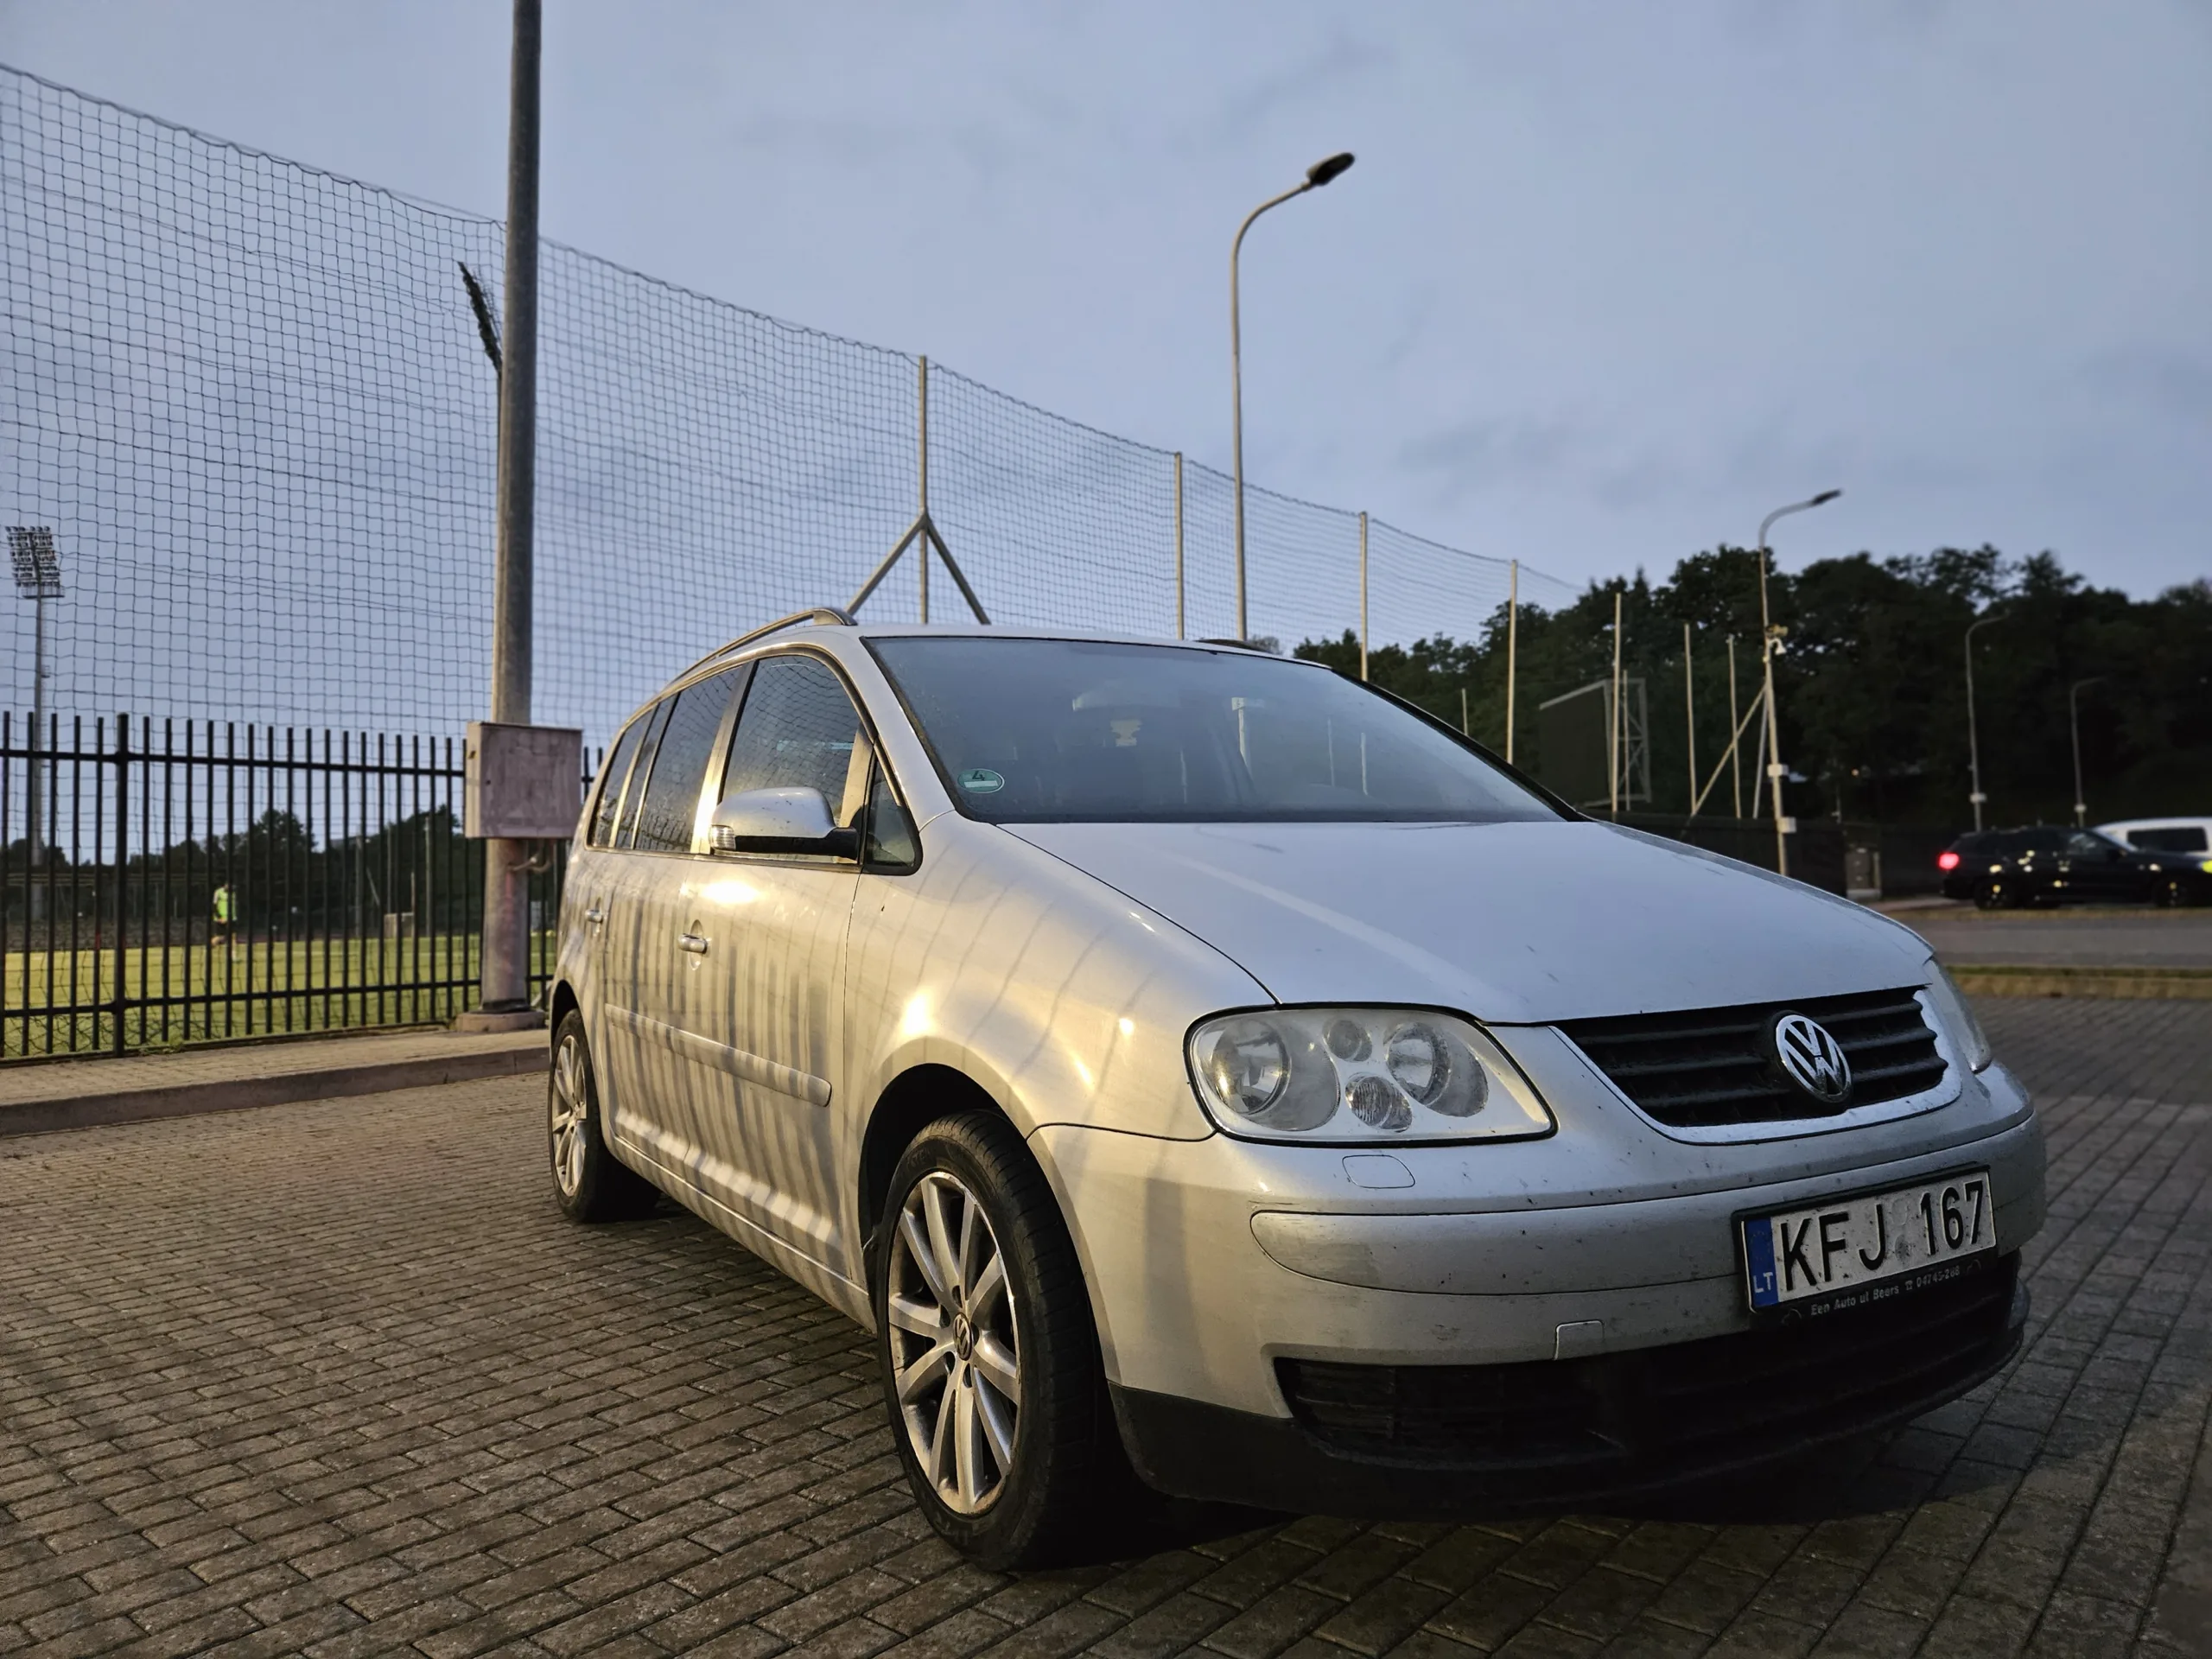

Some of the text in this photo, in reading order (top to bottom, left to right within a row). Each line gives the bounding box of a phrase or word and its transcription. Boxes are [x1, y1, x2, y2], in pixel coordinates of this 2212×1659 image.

[971, 770, 985, 781] 4
[1780, 1180, 1983, 1291] KFJ 167
[1753, 1271, 1774, 1294] LT
[1811, 1303, 1830, 1316] Een
[1834, 1295, 1856, 1310] Auto
[1872, 1285, 1900, 1300] Beers
